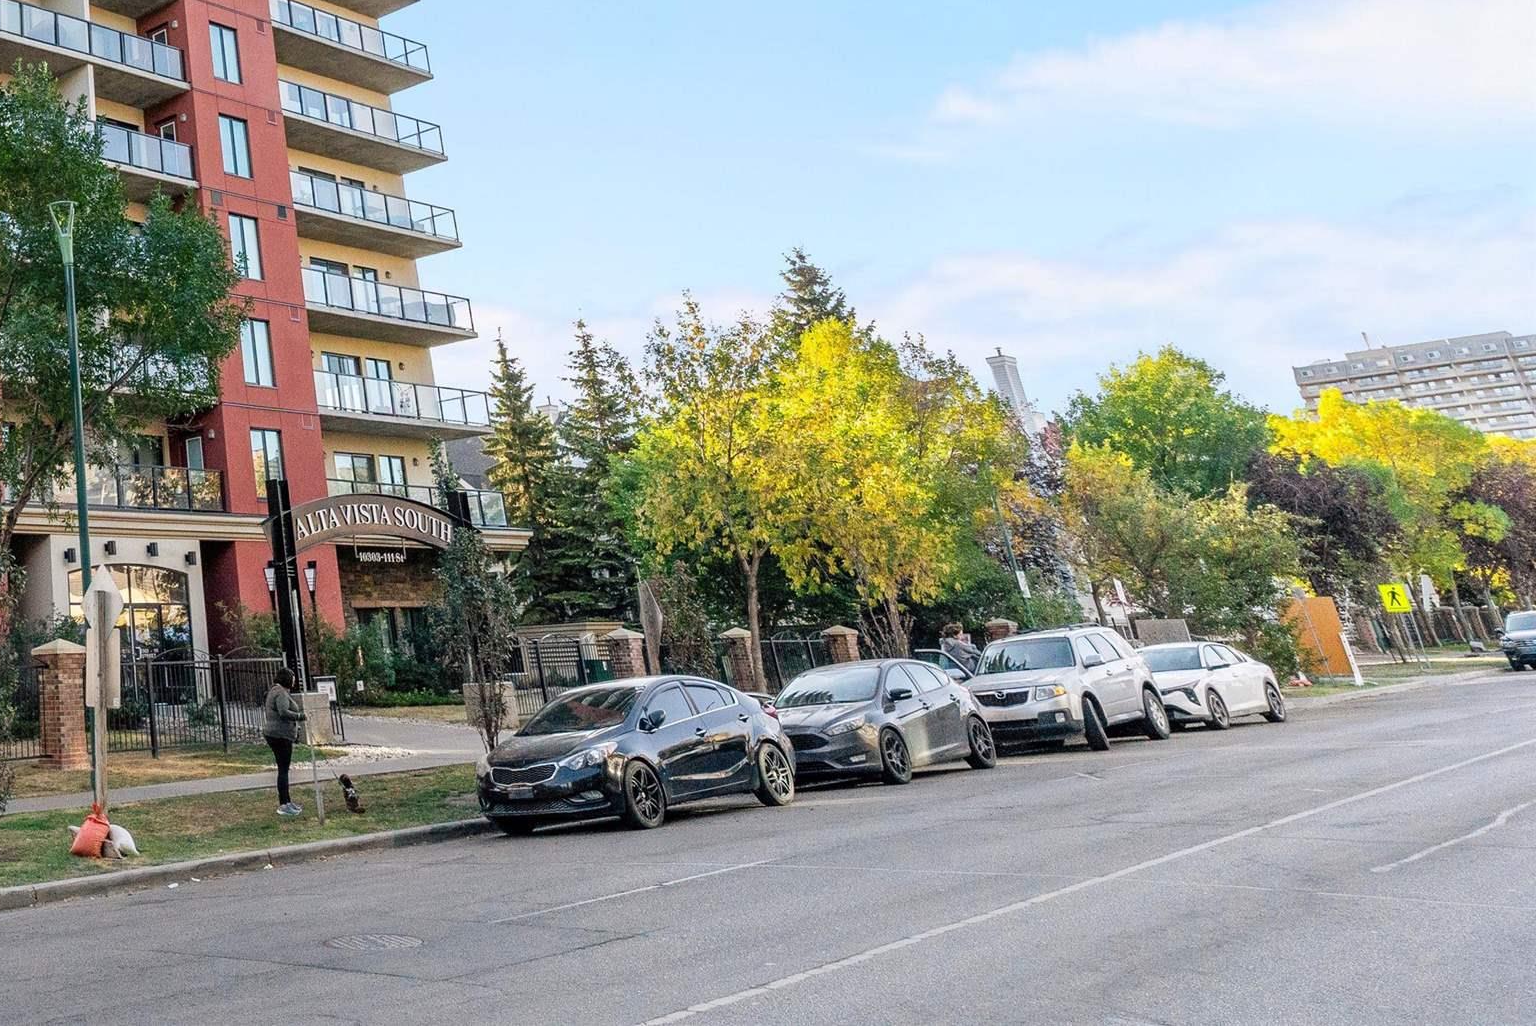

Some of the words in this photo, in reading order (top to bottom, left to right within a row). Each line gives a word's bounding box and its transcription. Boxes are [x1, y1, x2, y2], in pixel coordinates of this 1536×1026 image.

[296, 507, 342, 541] ALTA
[339, 503, 392, 526] VISTA
[393, 506, 453, 543] SOUTH
[358, 551, 395, 563] 10303-111
